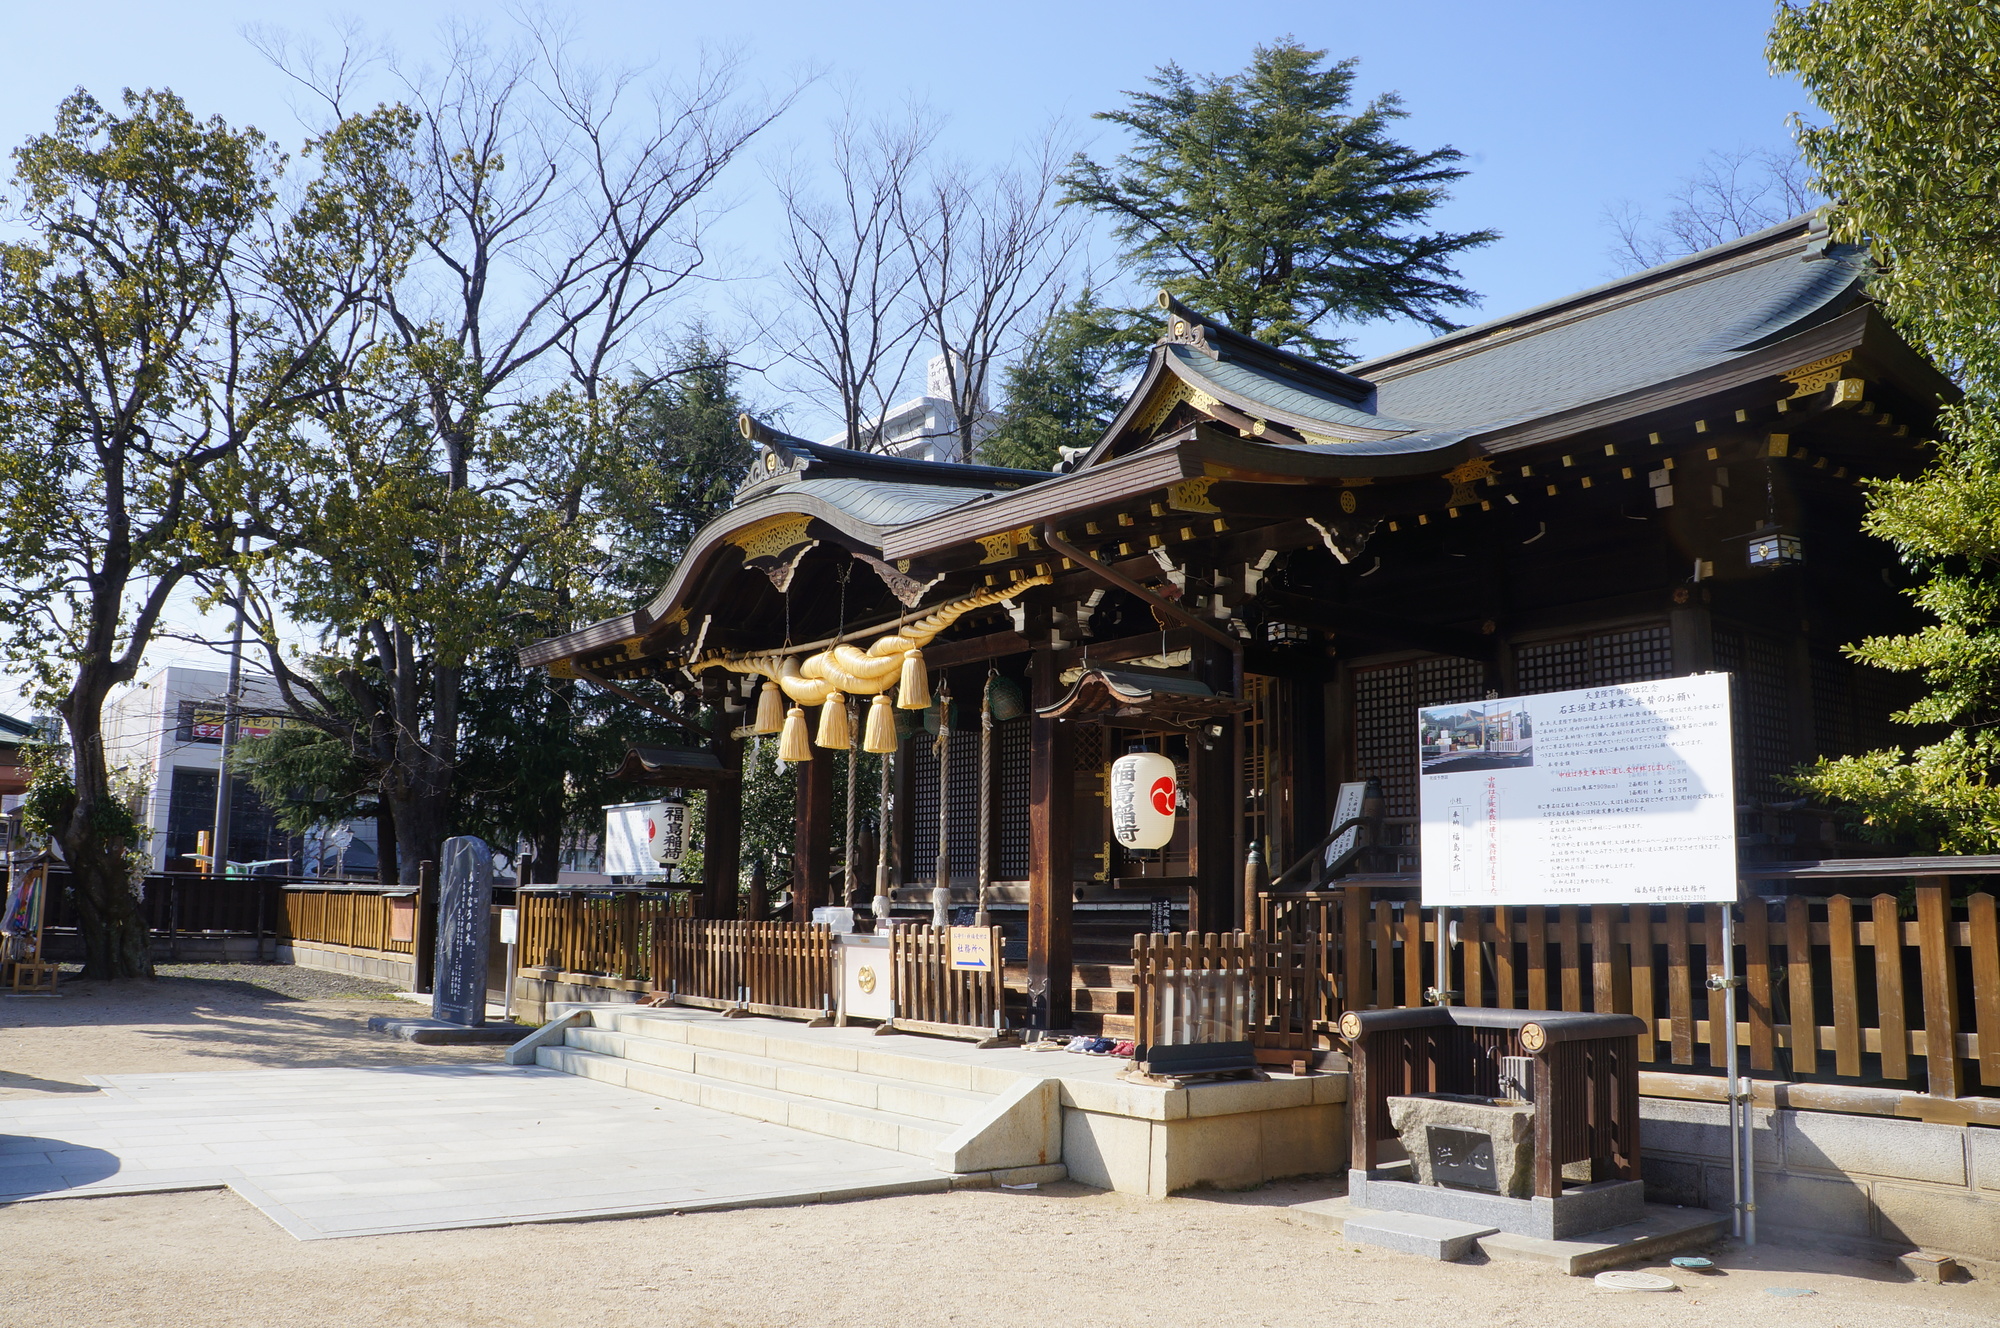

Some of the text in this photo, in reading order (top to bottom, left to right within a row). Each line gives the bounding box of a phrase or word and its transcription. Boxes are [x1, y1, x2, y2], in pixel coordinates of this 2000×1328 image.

[1558, 690, 1696, 715] 石玉垣建立事業ご奉賛のお願い
[1668, 777, 1687, 785] 25万円
[1112, 758, 1140, 843] 福島稲荷
[662, 806, 684, 860] 福島稲荷
[1633, 884, 1706, 894] 福島稲荷神社社務所
[957, 944, 984, 954] 社務所へ
